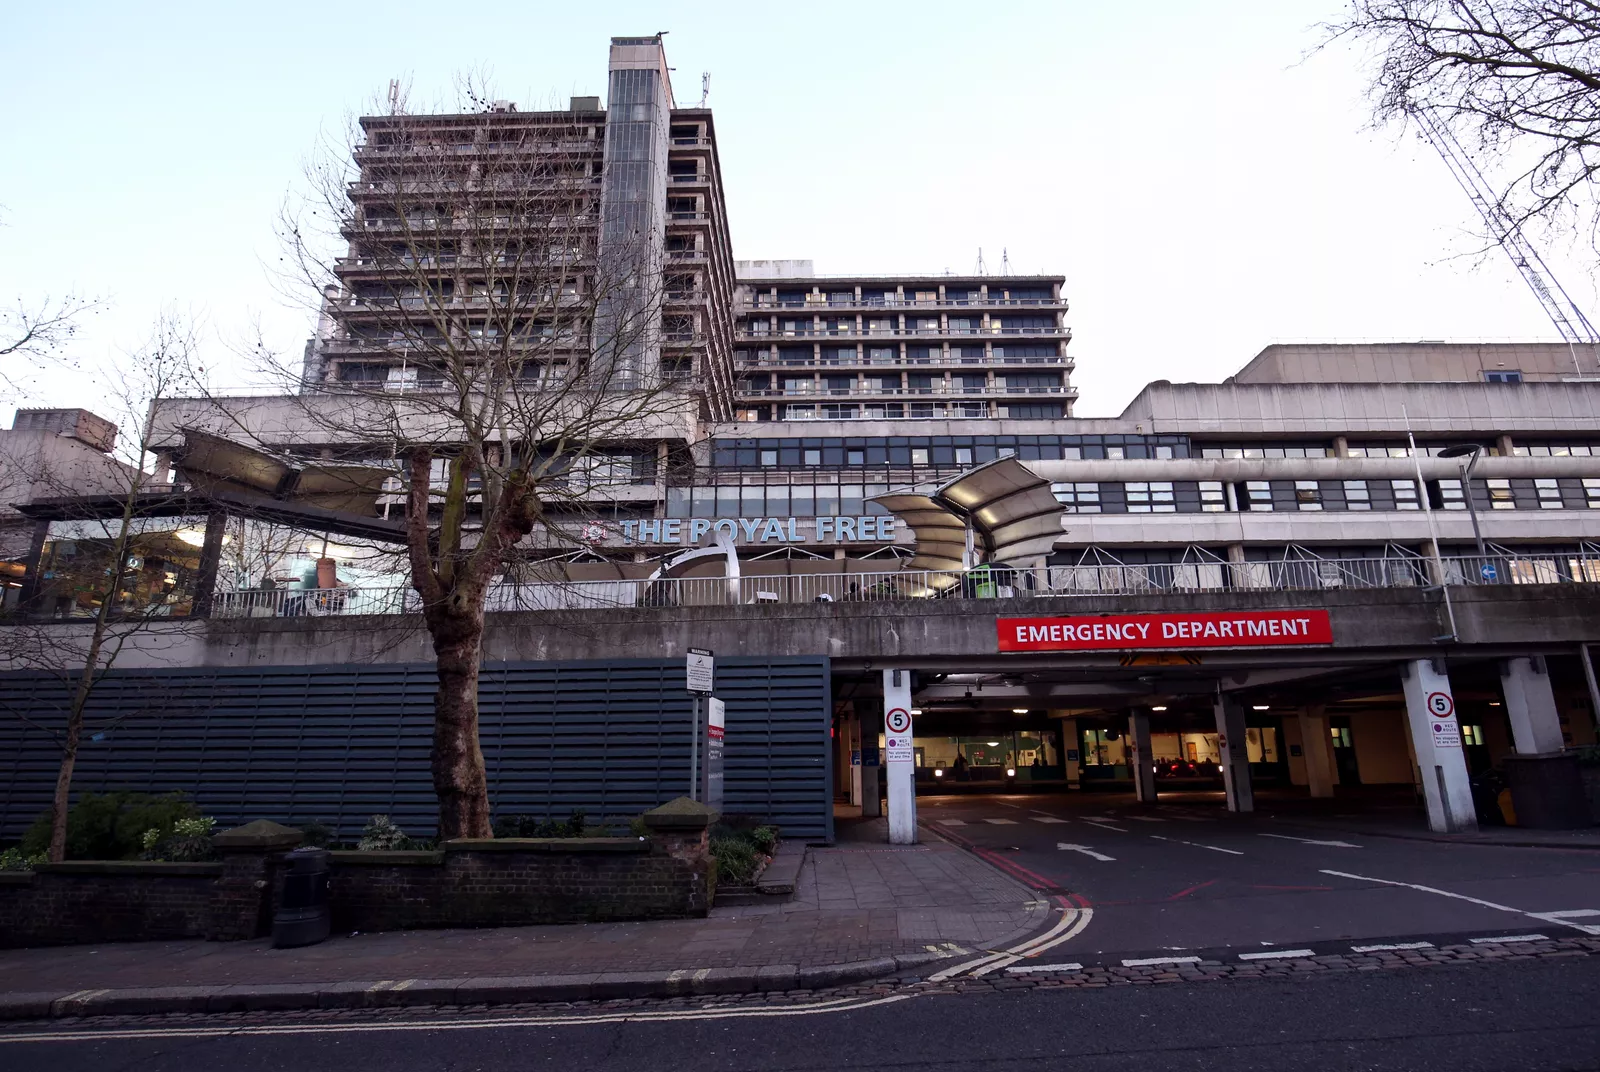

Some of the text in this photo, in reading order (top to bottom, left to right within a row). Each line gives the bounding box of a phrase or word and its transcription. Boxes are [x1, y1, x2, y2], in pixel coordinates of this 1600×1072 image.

[619, 515, 896, 543] THE ROYAL FREE
[1016, 618, 1310, 643] EMERGENCY DEPARTMENT
[1435, 698, 1445, 711] 5
[894, 714, 902, 726] 5
